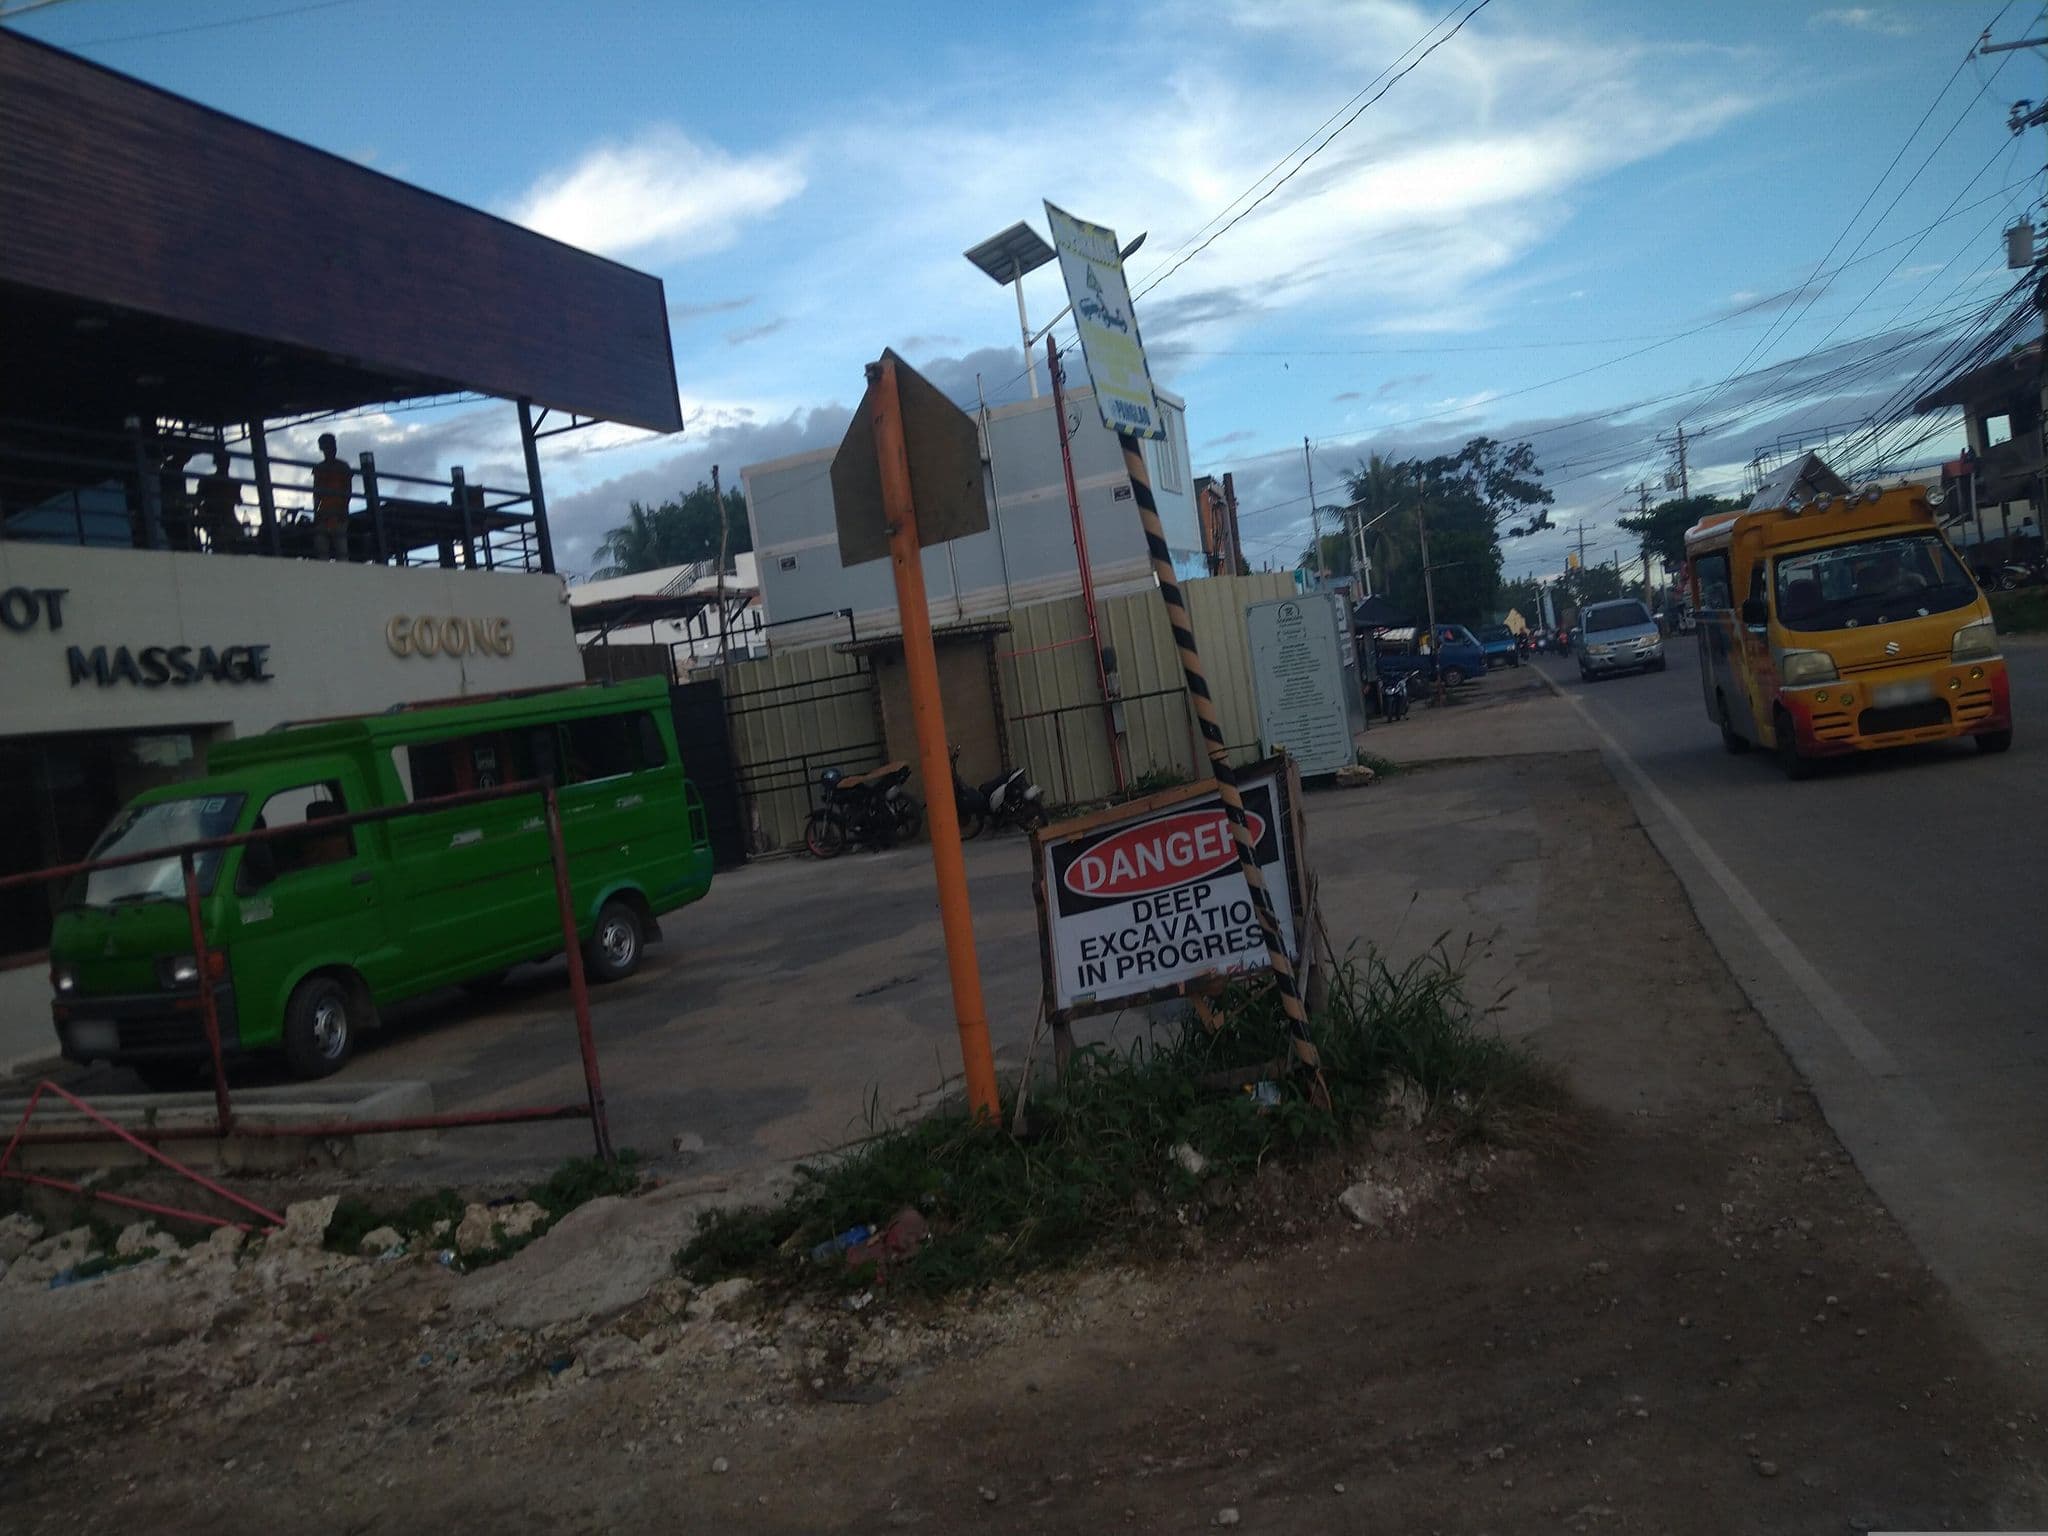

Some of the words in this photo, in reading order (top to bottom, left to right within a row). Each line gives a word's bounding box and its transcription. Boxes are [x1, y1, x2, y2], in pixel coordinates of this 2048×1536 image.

[0, 587, 69, 631] OT
[386, 614, 516, 660] GOONG
[67, 644, 274, 688] MASSAGE
[1132, 884, 1212, 924] DEEP
[1080, 900, 1258, 962] EXCAVATIO
[1077, 960, 1107, 989] IN
[1116, 924, 1265, 980] PROGRES
